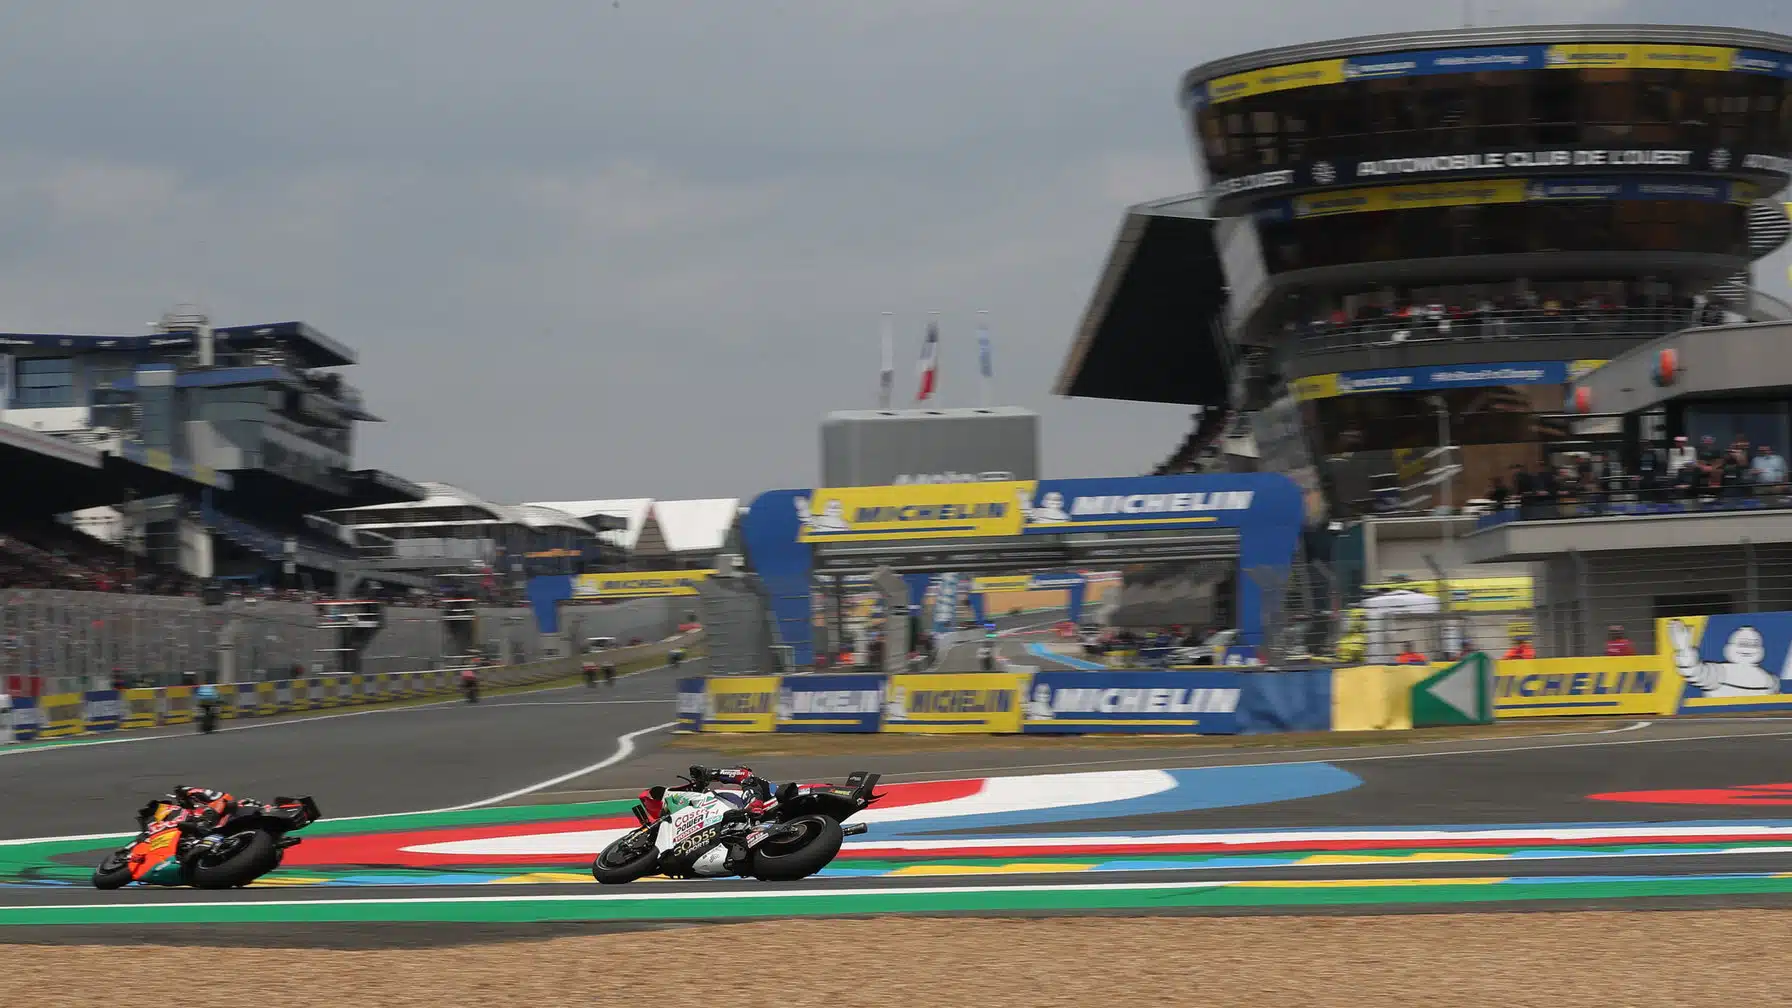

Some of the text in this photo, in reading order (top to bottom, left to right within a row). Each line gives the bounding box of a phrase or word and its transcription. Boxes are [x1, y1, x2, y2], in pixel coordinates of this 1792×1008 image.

[1356, 153, 1504, 177] AUTOMOBILE
[1505, 151, 1572, 167] CLUB
[1574, 150, 1609, 166] DE
[853, 502, 1010, 524] MICHELIN
[1070, 491, 1254, 516] MICHELIN
[1053, 688, 1241, 713] MICHELIN
